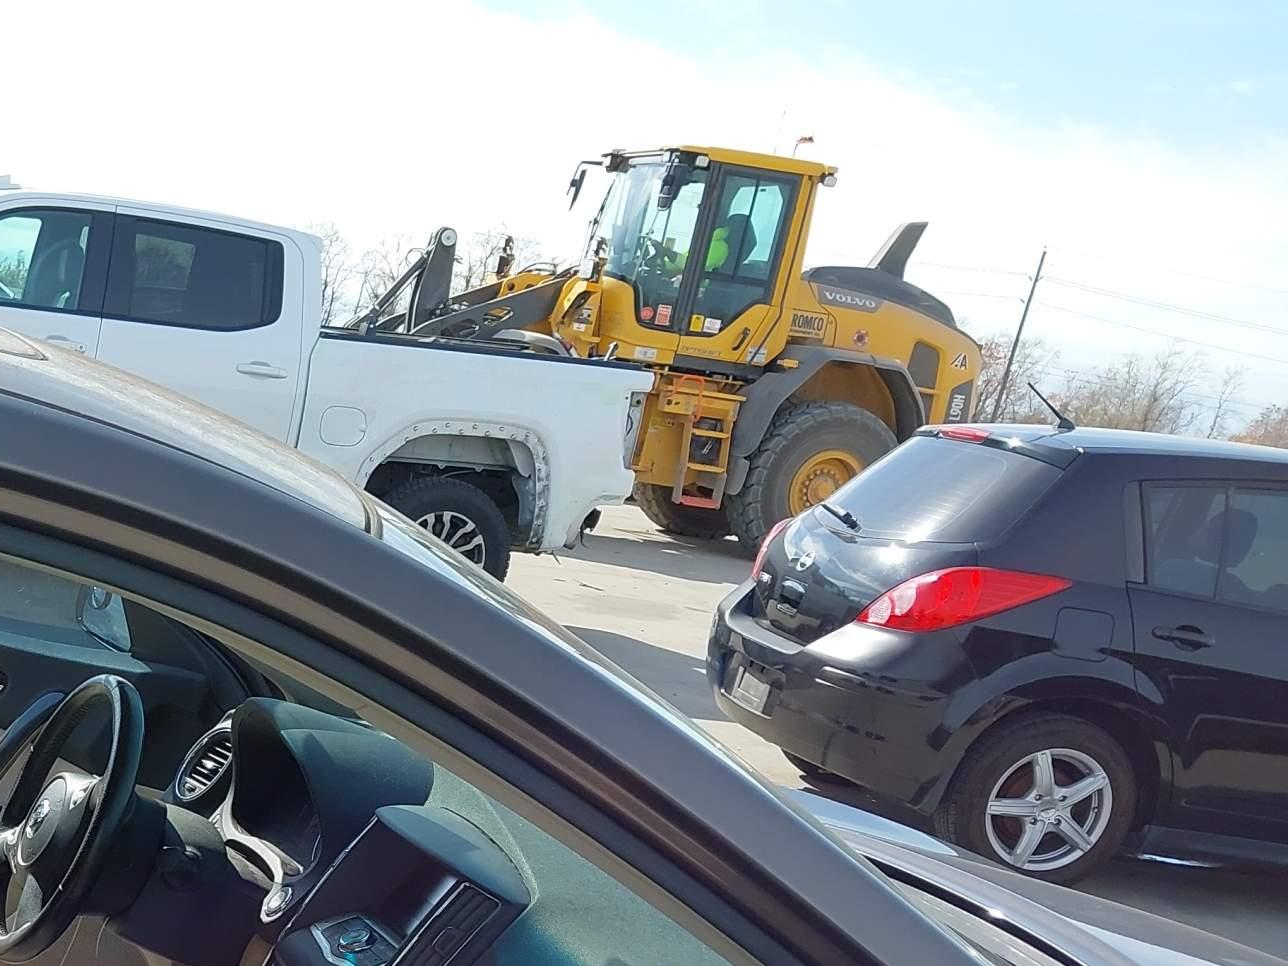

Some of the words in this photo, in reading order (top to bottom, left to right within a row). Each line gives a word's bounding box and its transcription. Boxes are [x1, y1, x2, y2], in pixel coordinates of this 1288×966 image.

[823, 290, 876, 308] VOLVO
[792, 313, 825, 332] ROMCO
[948, 394, 966, 421] L90H
